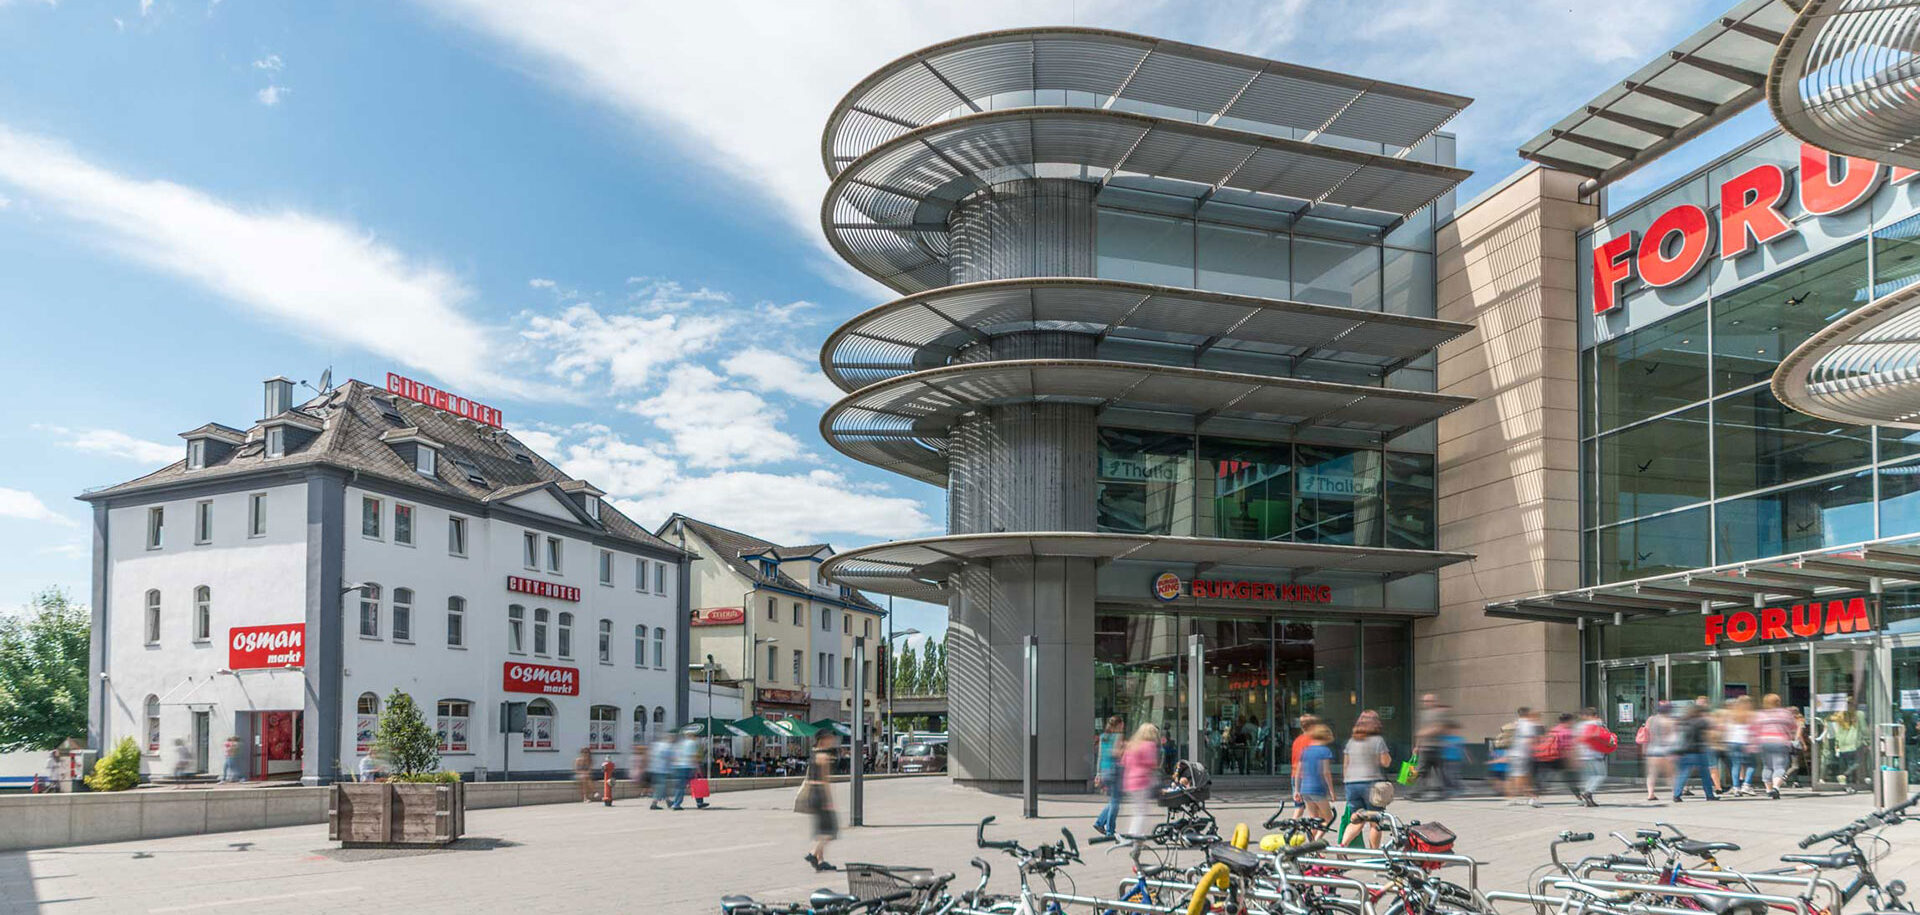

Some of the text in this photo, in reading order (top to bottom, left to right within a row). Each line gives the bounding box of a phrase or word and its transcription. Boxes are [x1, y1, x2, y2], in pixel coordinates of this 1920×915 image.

[1594, 142, 1920, 315] FORU
[388, 373, 502, 428] CITY-HOTEL
[508, 577, 580, 601] CITY-HOTEL
[1193, 579, 1332, 603] BURGER KING
[1705, 598, 1871, 645] FORUM
[267, 650, 301, 664] markt
[543, 684, 573, 694] markt
